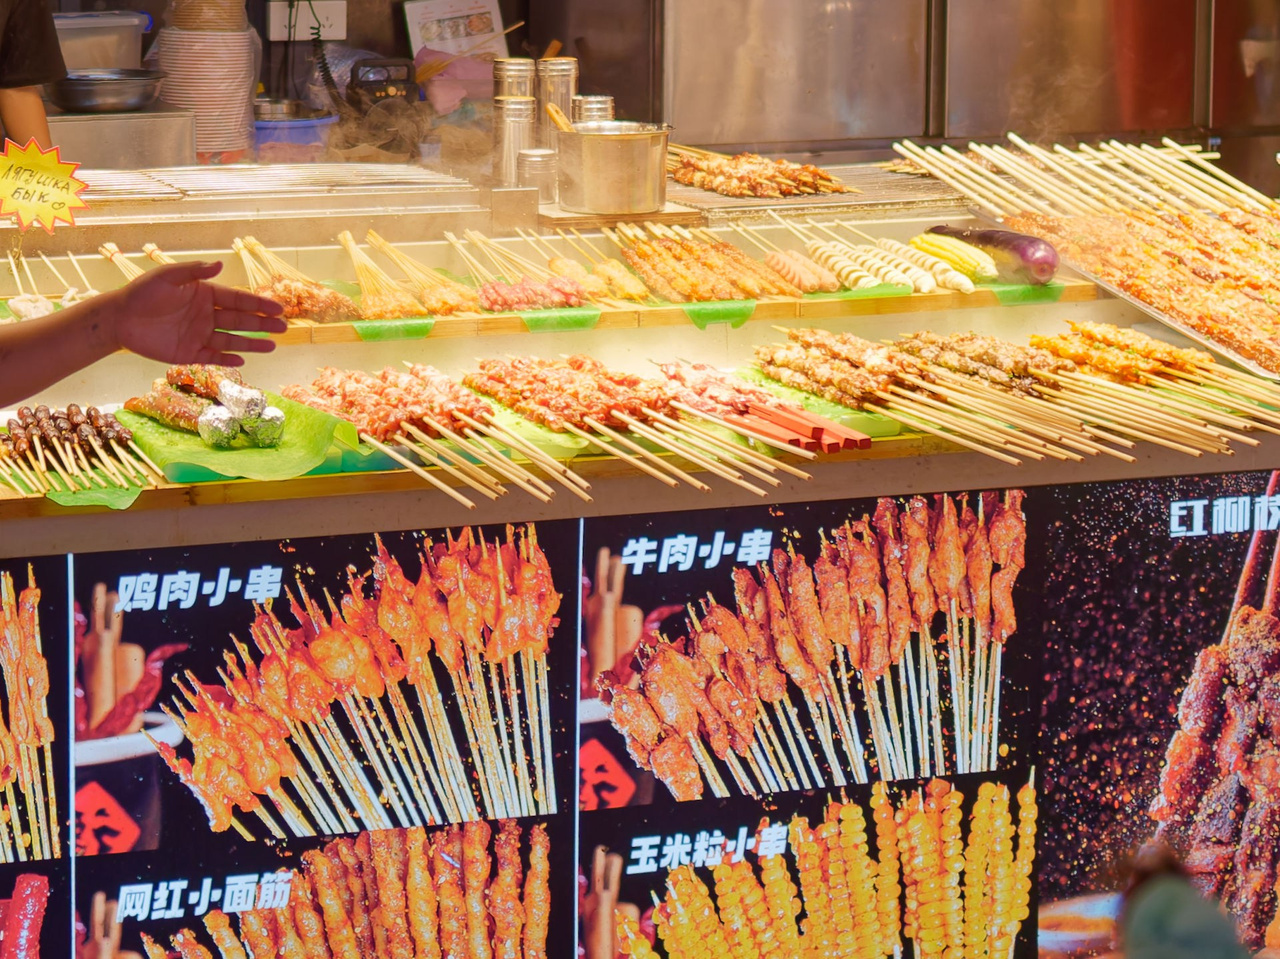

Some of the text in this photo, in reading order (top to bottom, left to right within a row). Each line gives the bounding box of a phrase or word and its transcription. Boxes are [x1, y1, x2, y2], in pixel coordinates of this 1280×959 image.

[10, 187, 50, 204] БЫК
[620, 528, 773, 575] 牛肉小串
[113, 565, 283, 613] 鸡肉小串
[626, 823, 789, 875] 玉米粒小串
[114, 869, 294, 924] 网红小面筋
